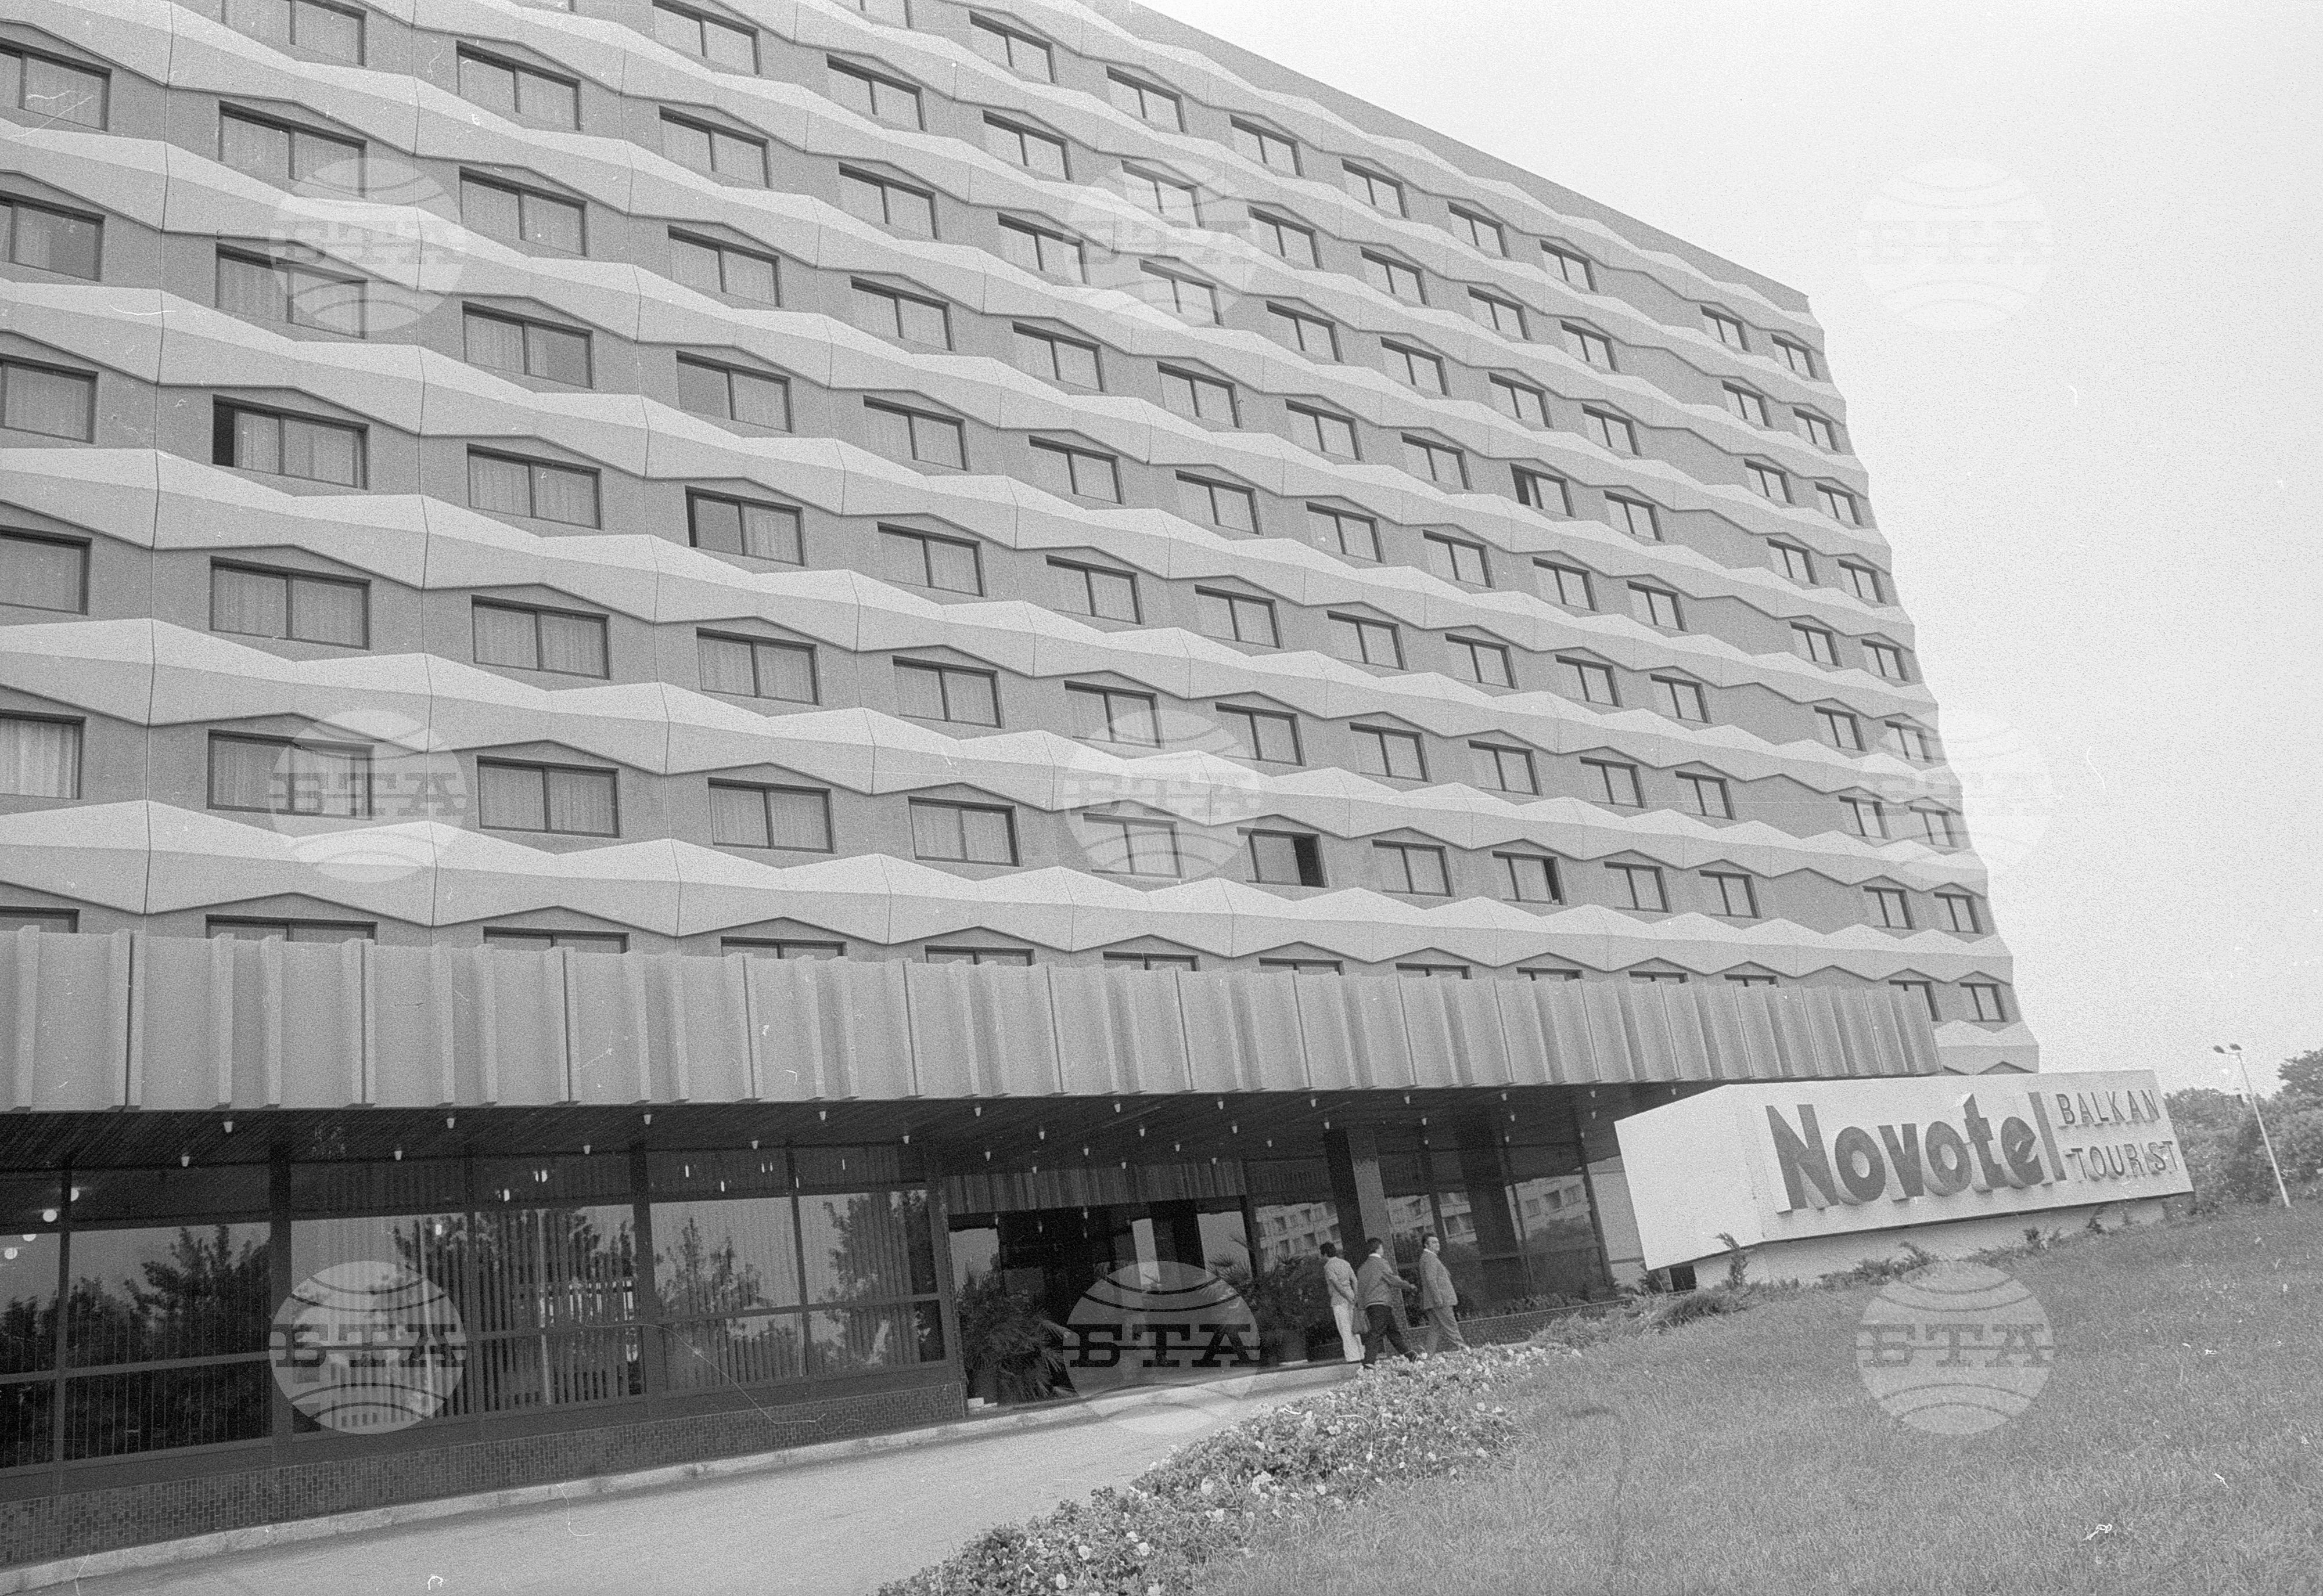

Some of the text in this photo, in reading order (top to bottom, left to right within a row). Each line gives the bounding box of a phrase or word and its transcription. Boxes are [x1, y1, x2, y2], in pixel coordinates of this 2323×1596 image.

[2056, 1089, 2161, 1125] BALKAN
[1765, 1091, 2066, 1212] Novotel
[2069, 1140, 2178, 1179] TOURIST
